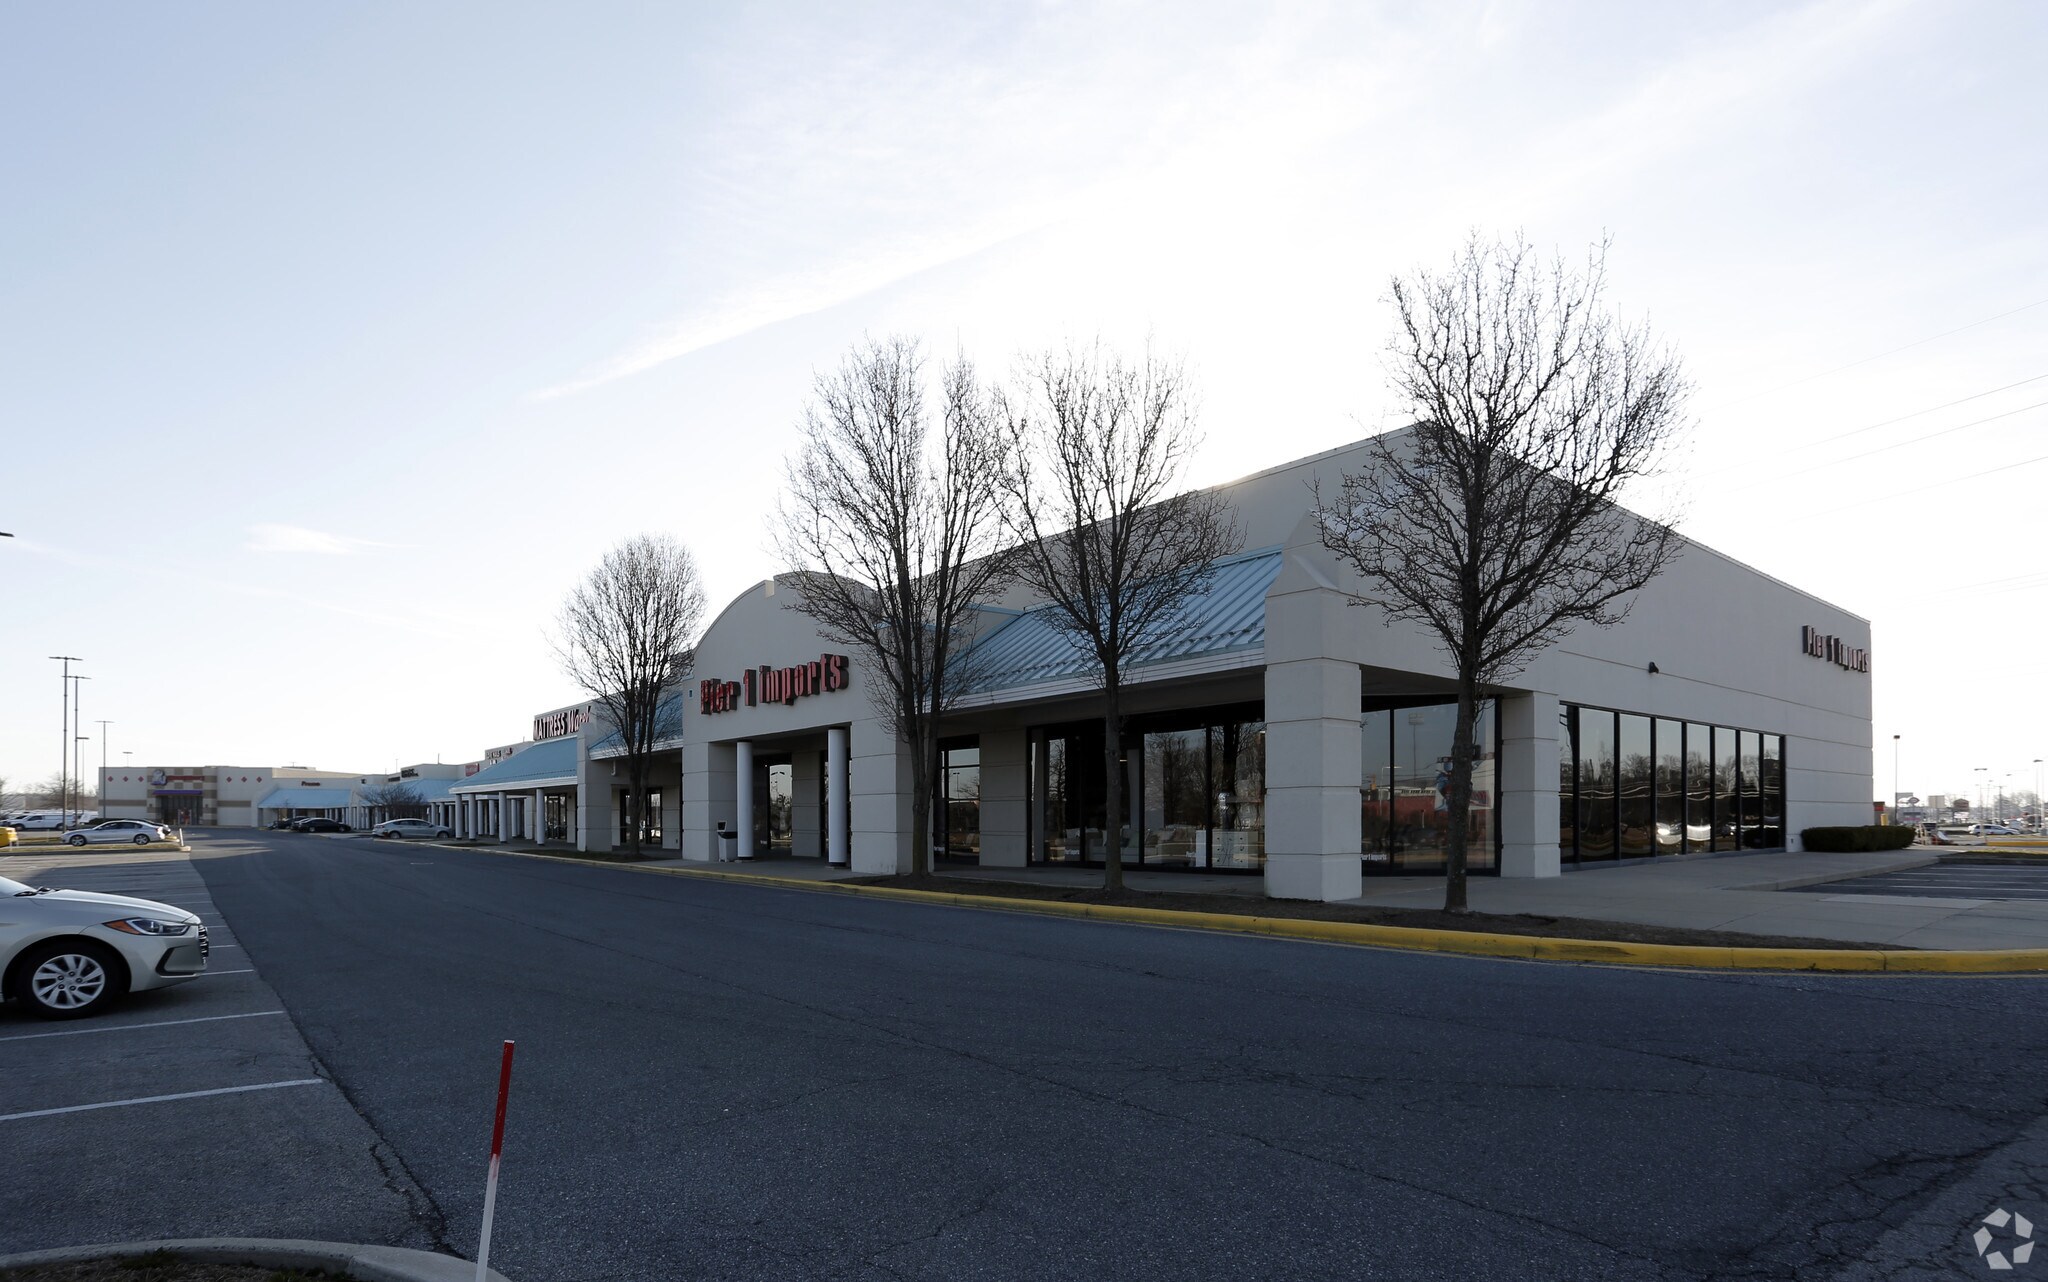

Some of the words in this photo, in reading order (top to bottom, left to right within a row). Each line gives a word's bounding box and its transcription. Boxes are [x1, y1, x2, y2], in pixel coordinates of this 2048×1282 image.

[701, 678, 741, 715] Pier
[743, 669, 756, 706] 1
[533, 712, 567, 741] MATTRESS
